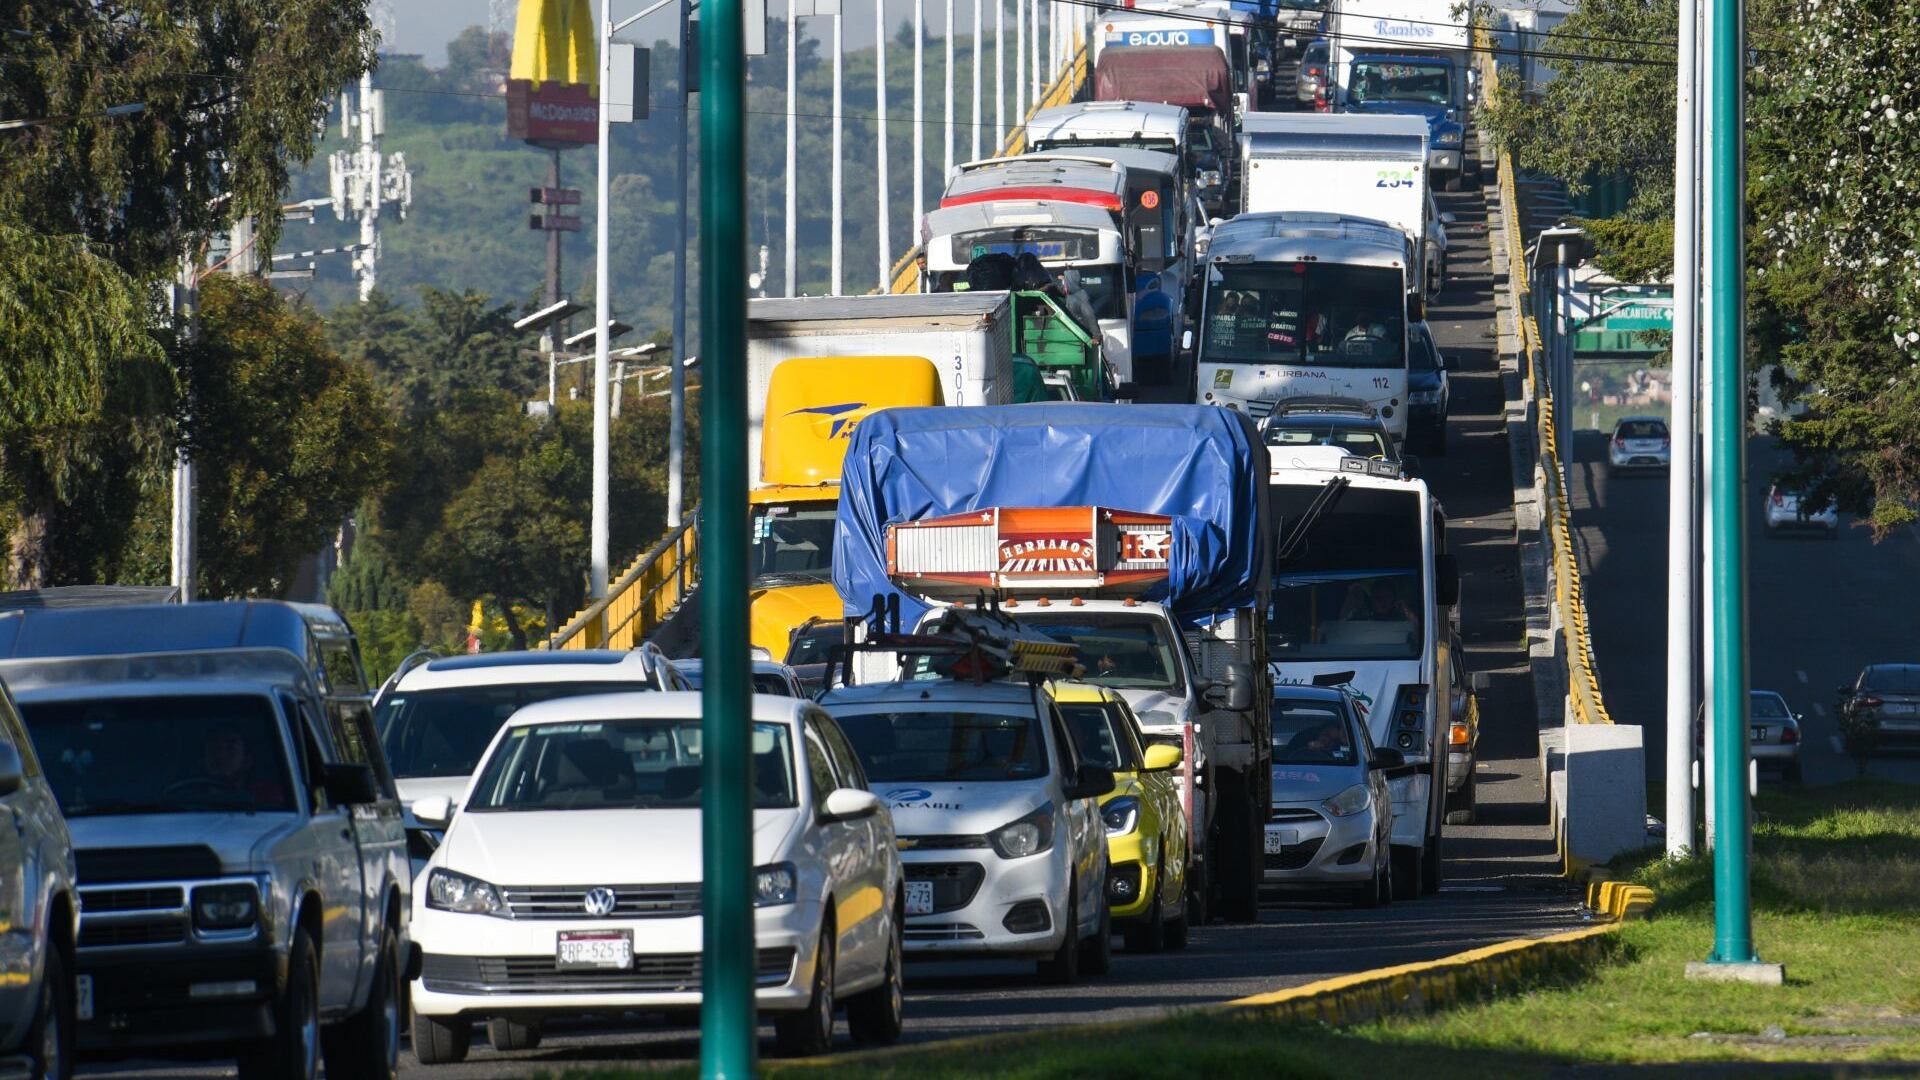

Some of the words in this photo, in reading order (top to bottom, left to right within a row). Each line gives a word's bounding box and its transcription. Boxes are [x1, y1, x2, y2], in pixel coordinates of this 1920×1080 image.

[530, 102, 597, 121] McDonald's
[1376, 171, 1414, 188] 234
[1277, 370, 1327, 380] URBANA
[1372, 377, 1390, 389] 112
[1002, 539, 1093, 559] HERMANOS
[1000, 558, 1093, 572] MARTINEZ
